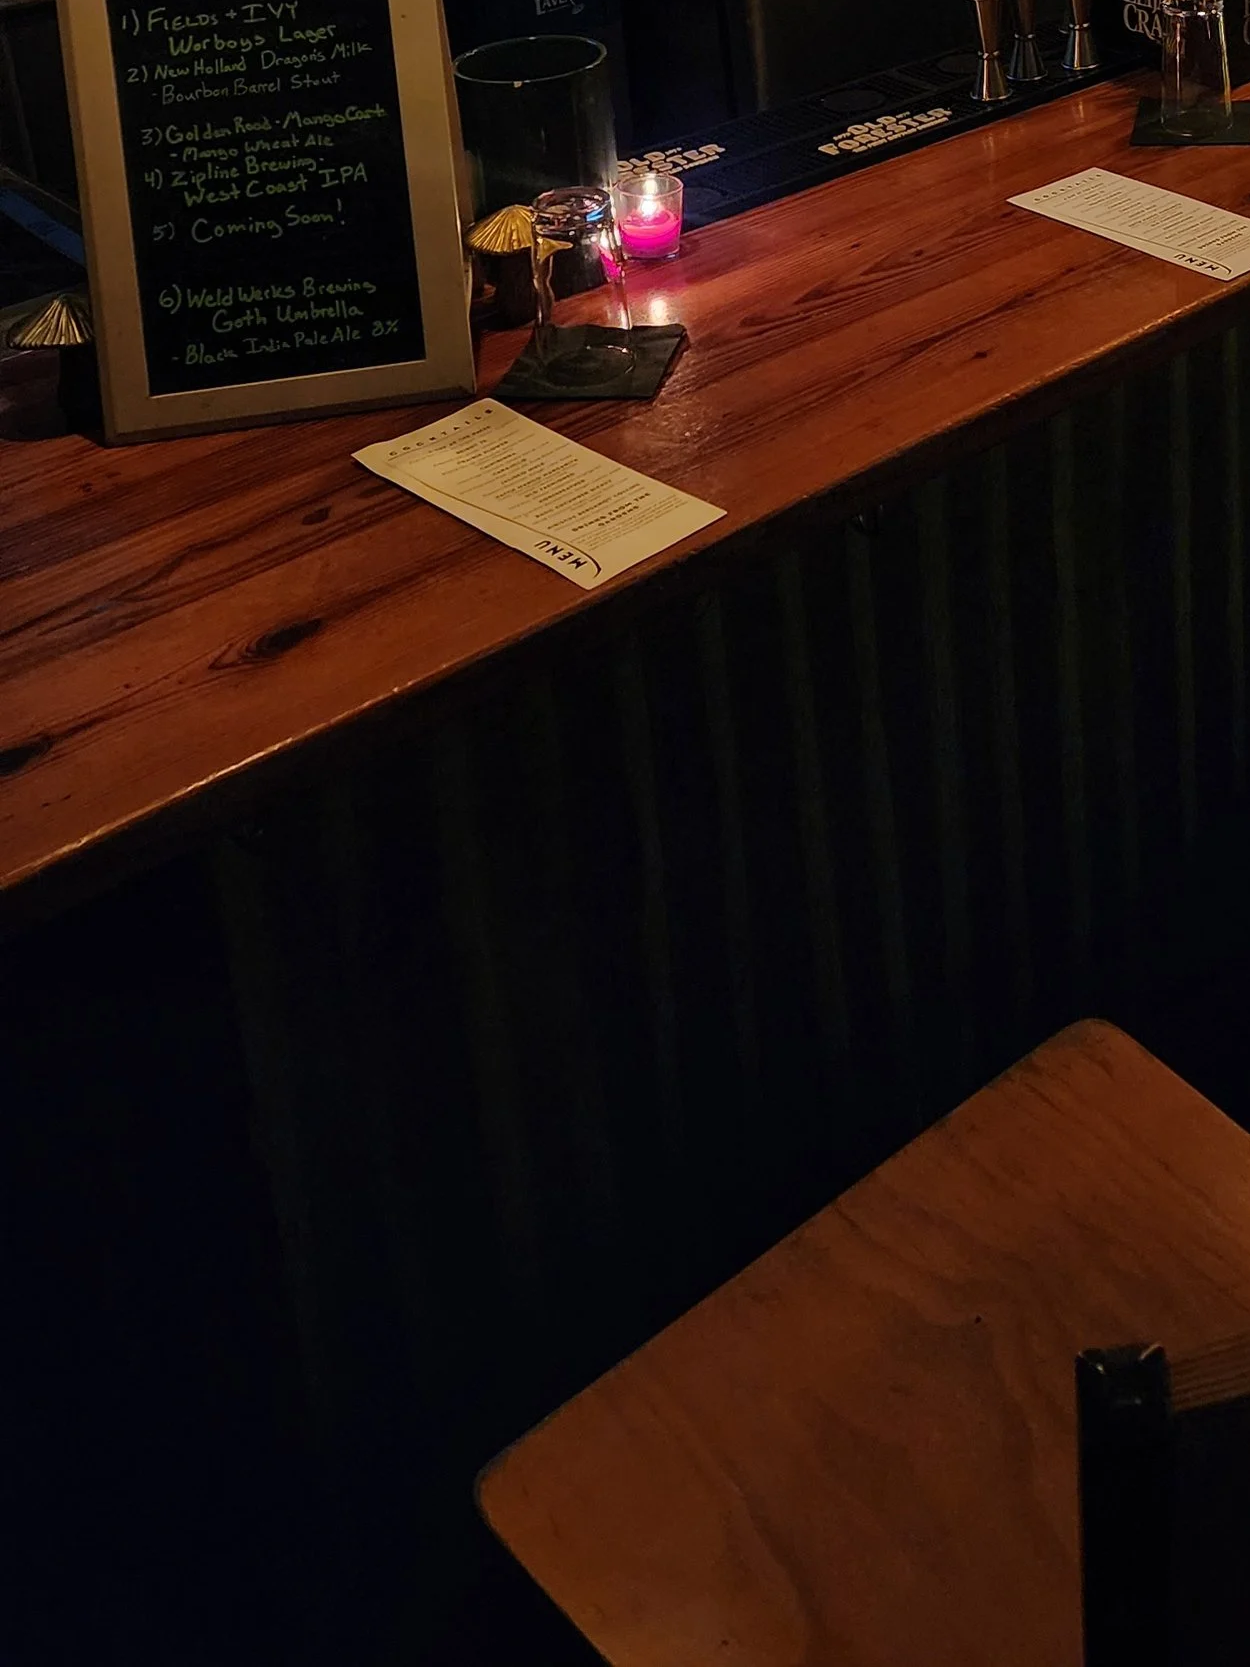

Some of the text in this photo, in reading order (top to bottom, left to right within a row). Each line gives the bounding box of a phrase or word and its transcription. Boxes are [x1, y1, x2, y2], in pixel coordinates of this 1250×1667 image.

[121, 7, 140, 37] 1)
[147, 7, 219, 33] FIELDS
[241, 0, 299, 24] IVY
[168, 25, 337, 57] Worboys Lager
[126, 65, 148, 84] 2)
[154, 63, 190, 81] New
[193, 55, 247, 76] Holland
[330, 42, 373, 61] Milk
[161, 81, 229, 106] Bourbon
[233, 77, 281, 97] Barrel
[290, 71, 341, 90] Stout
[140, 127, 163, 146] 3)
[165, 124, 232, 145] Golden
[233, 116, 272, 135] Road
[818, 108, 953, 156] FORESTER
[847, 115, 897, 136] OLD
[182, 146, 239, 163] Mango
[244, 135, 300, 153] Wheat
[304, 133, 335, 148] Ale
[171, 162, 240, 188] Zipline
[185, 162, 368, 208] West Coast IPA
[152, 198, 347, 244] 5) Coming Soon!
[1174, 253, 1220, 272] MENU
[158, 283, 182, 315] 6)
[302, 277, 377, 298] Brewing
[212, 300, 365, 334] Goth Umbrella
[185, 342, 239, 367] Black
[242, 338, 292, 355] India
[293, 331, 328, 349] Pale
[331, 326, 362, 343] Ale
[534, 540, 589, 569] MENU
